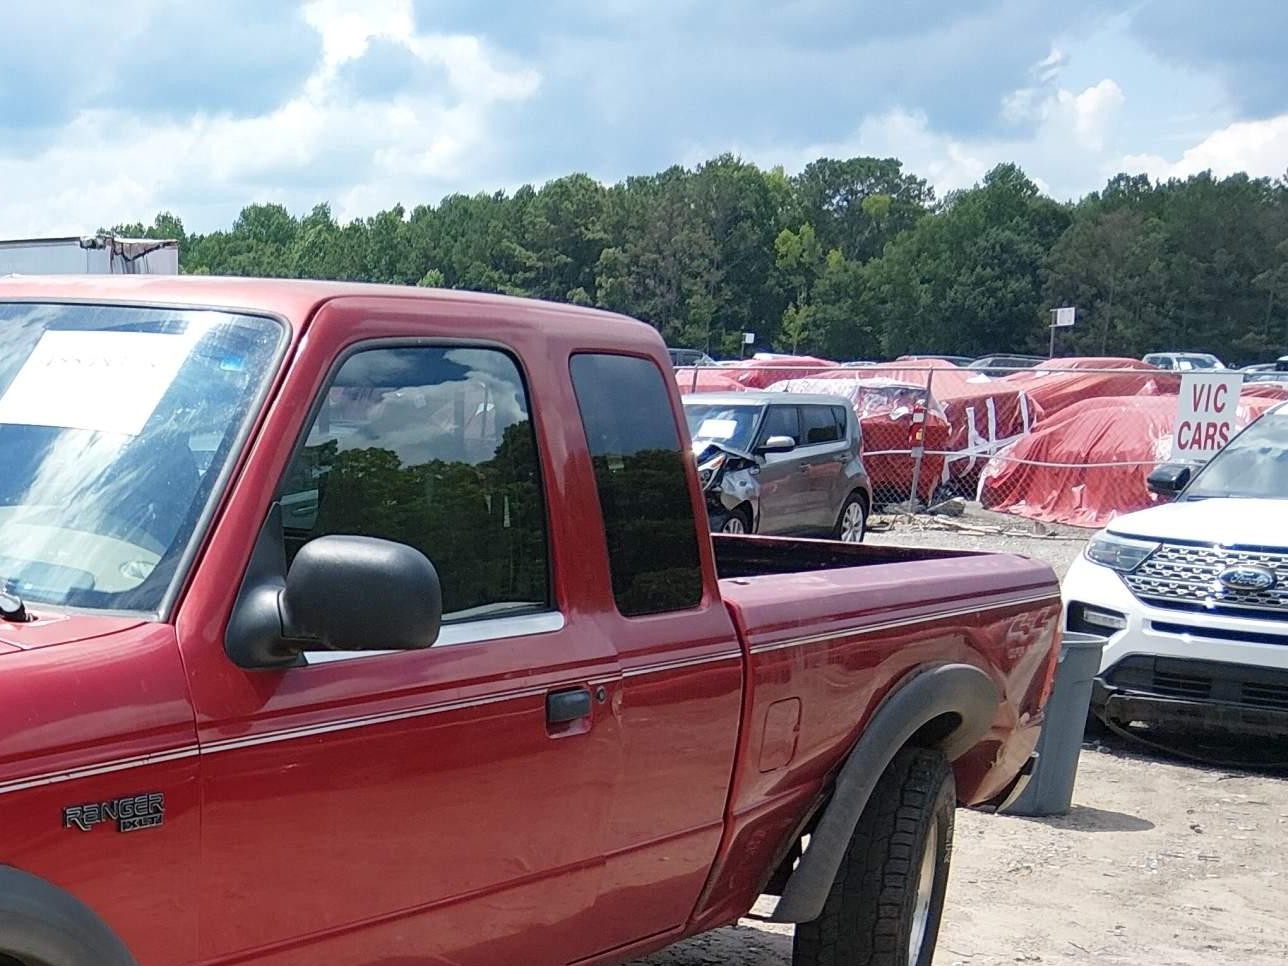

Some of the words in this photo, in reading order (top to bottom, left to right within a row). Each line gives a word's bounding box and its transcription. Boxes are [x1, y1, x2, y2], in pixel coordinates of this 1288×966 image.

[1193, 383, 1228, 413] VIC
[1177, 420, 1230, 450] CARS
[65, 792, 165, 832] RANGER
